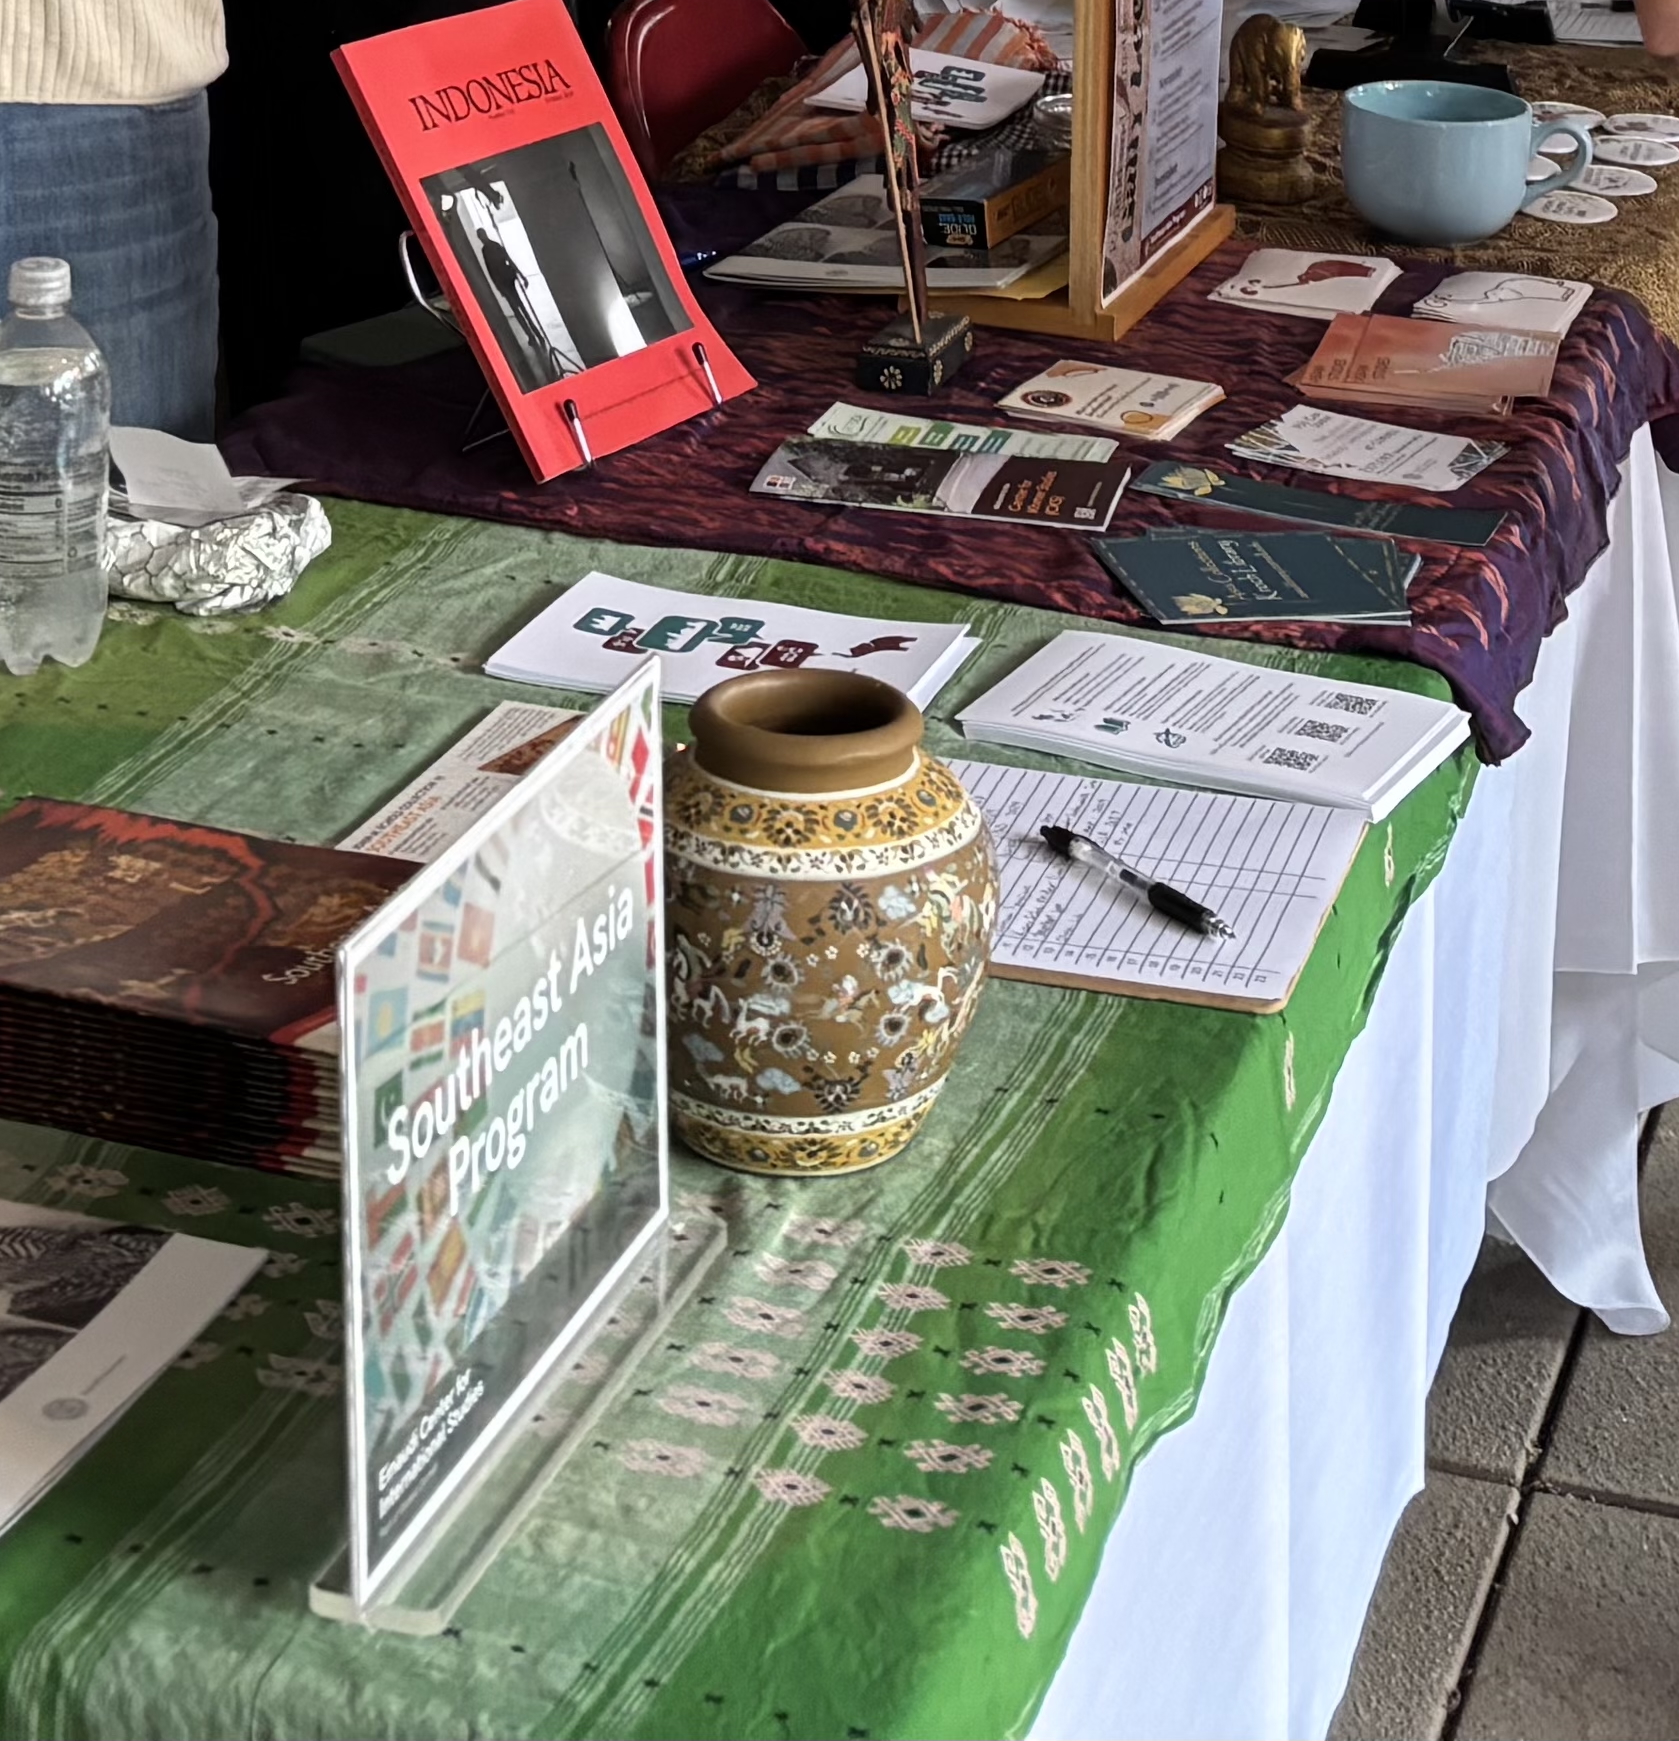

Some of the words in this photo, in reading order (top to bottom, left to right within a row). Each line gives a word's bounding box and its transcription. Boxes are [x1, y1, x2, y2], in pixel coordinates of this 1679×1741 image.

[408, 59, 571, 133] INDONESIA
[386, 965, 562, 1186] Southeast
[570, 884, 635, 999] Asia
[448, 1023, 590, 1218] Program
[420, 1386, 456, 1439] Center
[456, 1367, 473, 1396] for
[447, 1379, 485, 1434] Studies
